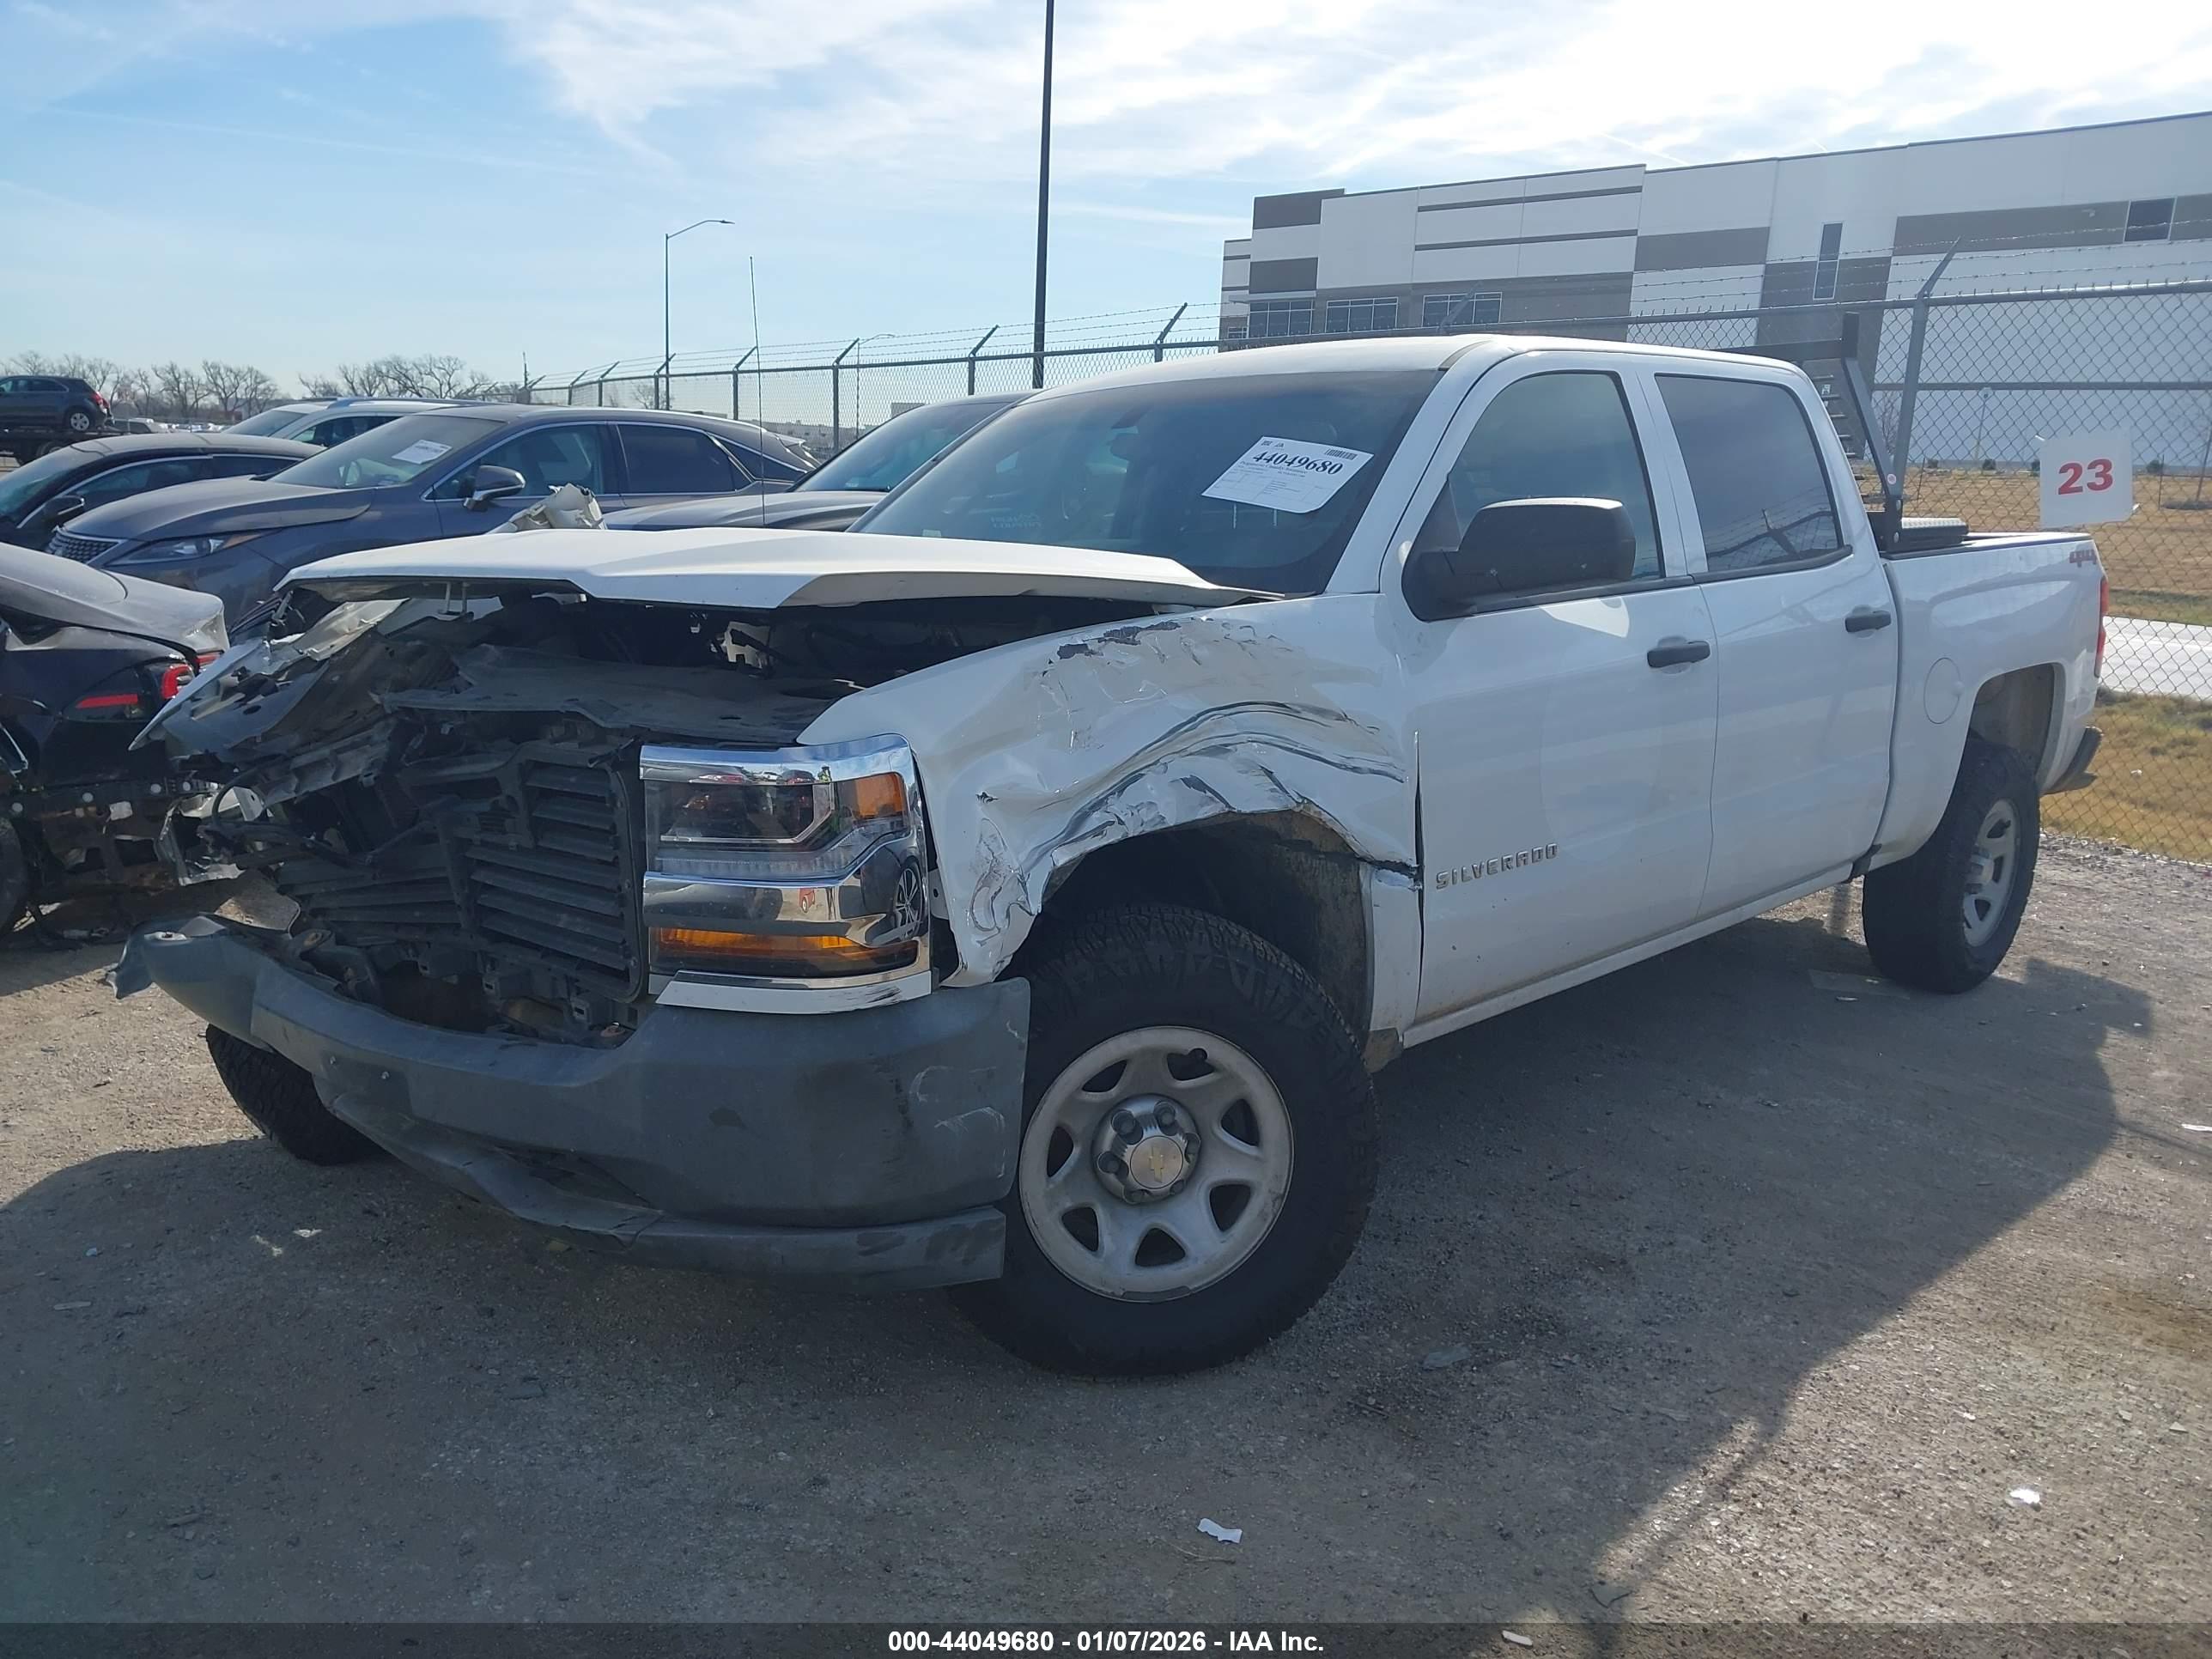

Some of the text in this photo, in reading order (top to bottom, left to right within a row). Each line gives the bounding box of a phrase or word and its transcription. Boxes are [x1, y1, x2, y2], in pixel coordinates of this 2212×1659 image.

[1253, 452, 1343, 475] 44049680
[2057, 459, 2113, 495] 23
[1436, 842, 1559, 890] SILVERADO
